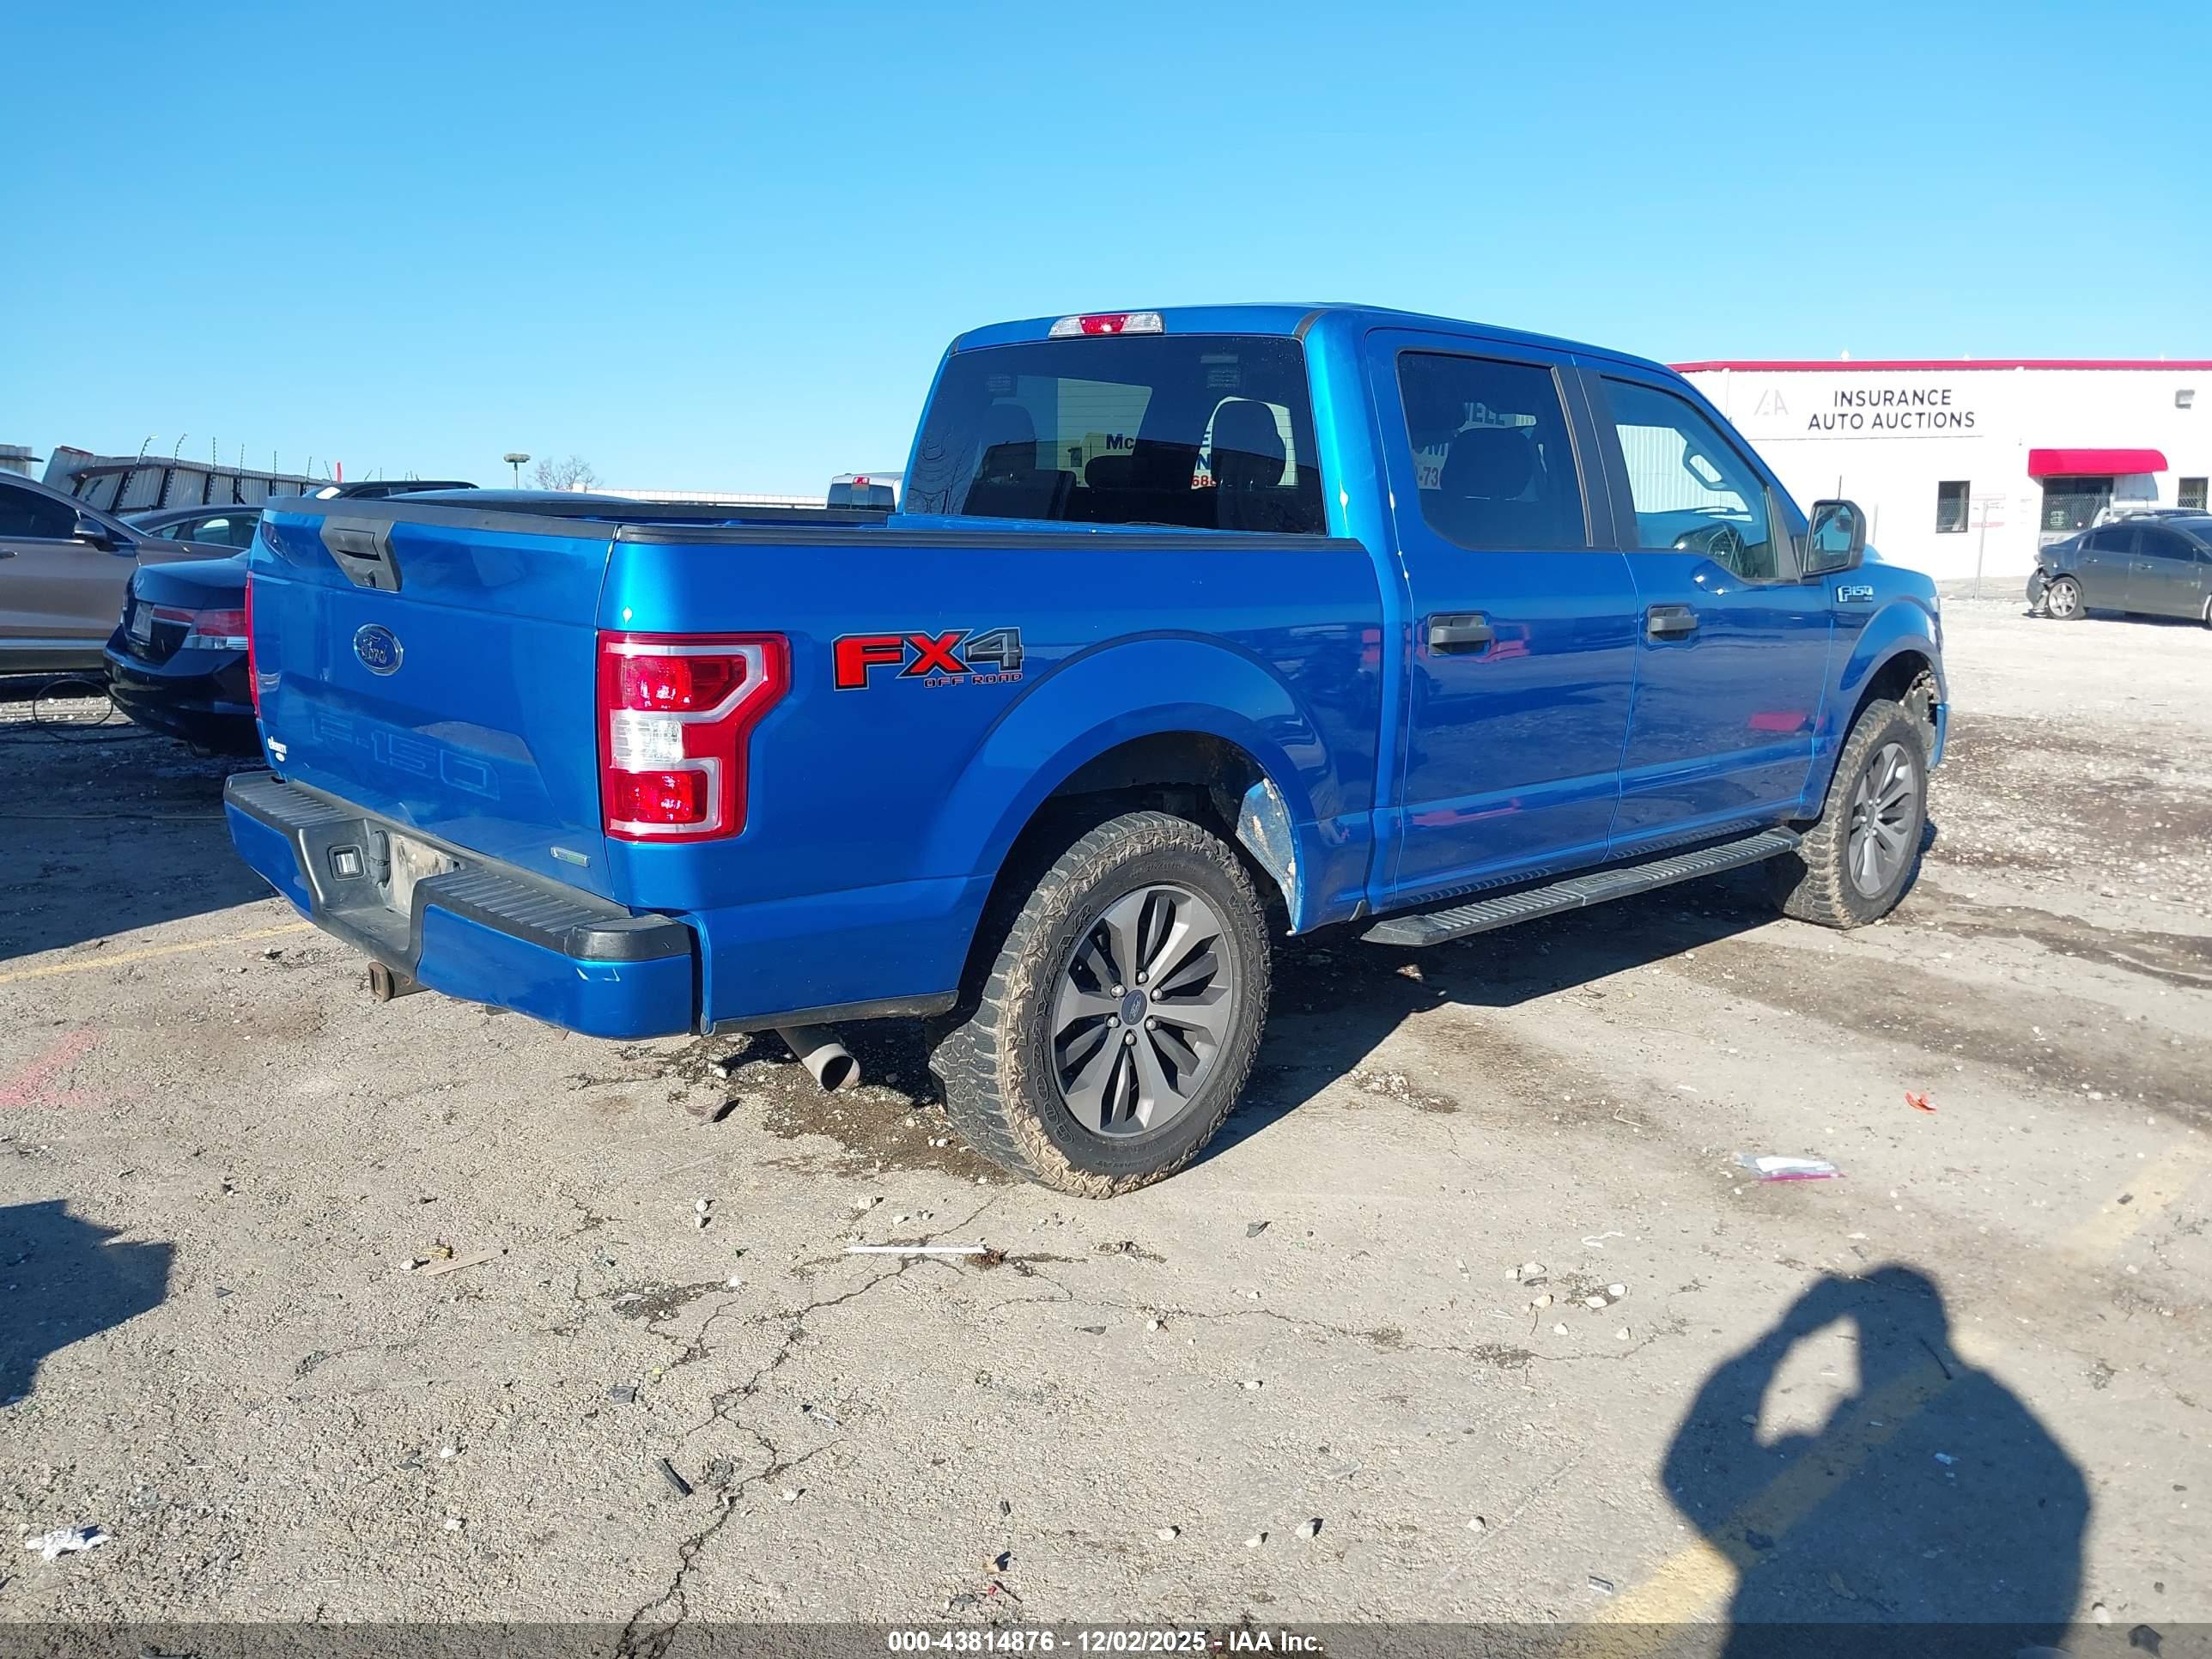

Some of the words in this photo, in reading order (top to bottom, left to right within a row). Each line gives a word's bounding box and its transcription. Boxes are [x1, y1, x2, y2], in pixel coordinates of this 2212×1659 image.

[1834, 389, 1952, 408] INSURANCE
[1808, 413, 1864, 430] AUTO
[1871, 411, 1975, 429] AUCTIONS
[831, 627, 1024, 691] FX4
[923, 676, 963, 688] OFF
[971, 672, 1024, 684] ROAD
